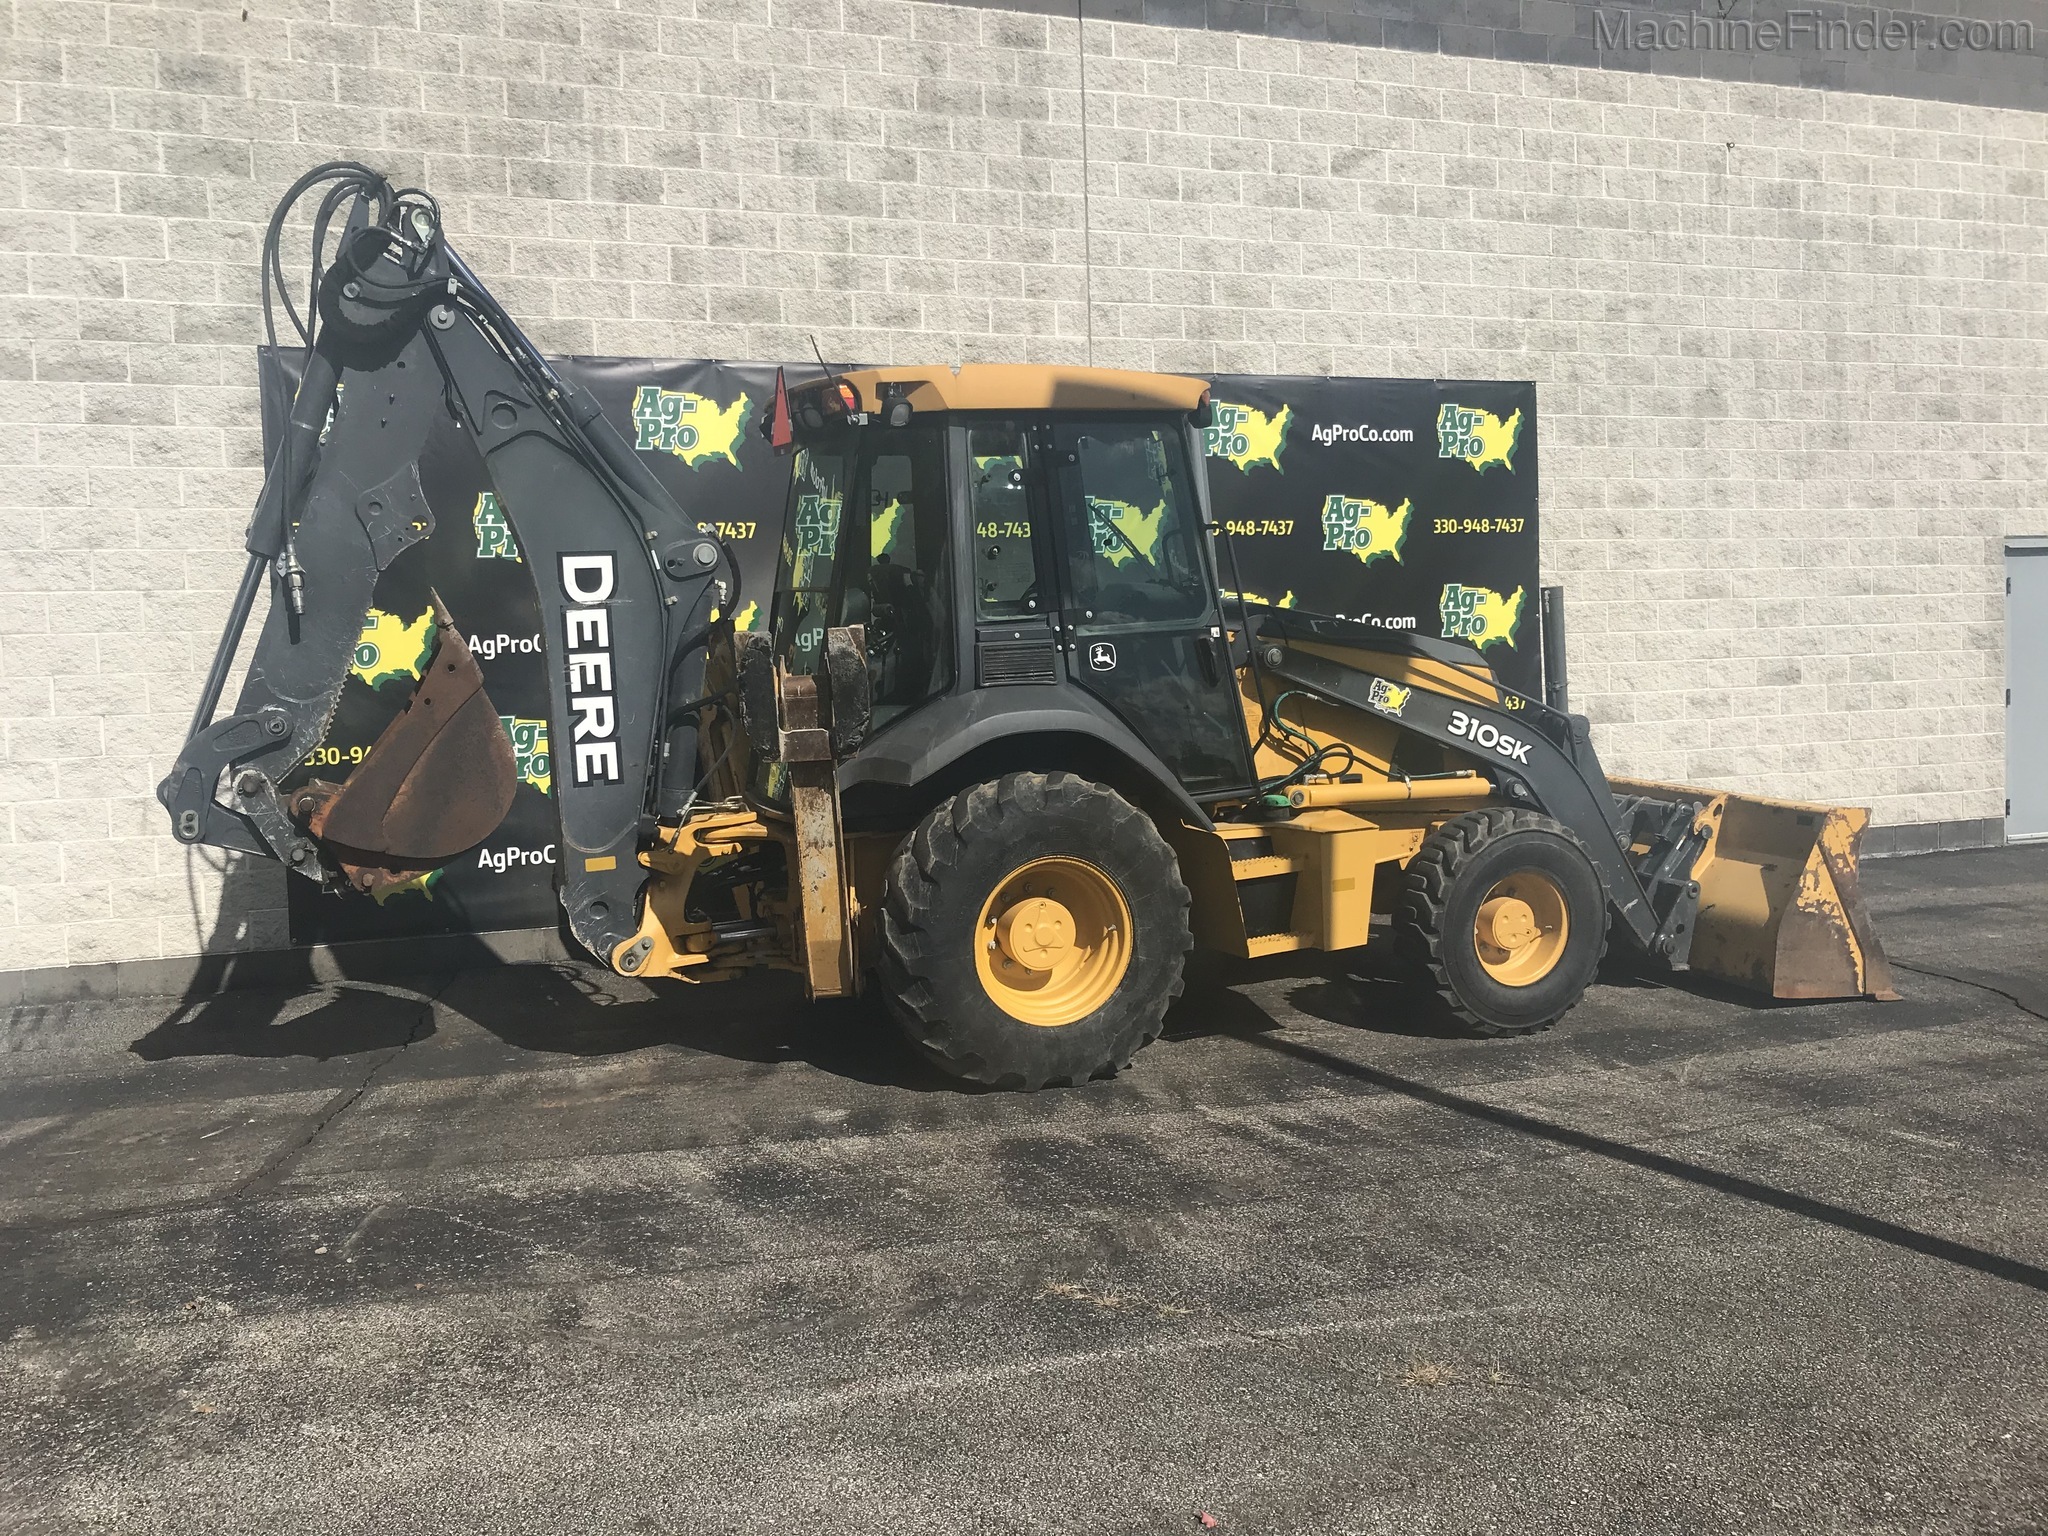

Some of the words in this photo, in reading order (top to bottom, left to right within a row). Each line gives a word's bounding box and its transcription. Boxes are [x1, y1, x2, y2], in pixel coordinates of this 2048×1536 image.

[634, 386, 697, 425] Ag-
[1438, 403, 1484, 437] Ag-
[635, 418, 699, 451] Pro
[1203, 429, 1250, 457] Pro
[1311, 424, 1414, 446] AgProCo.com
[1438, 430, 1486, 458] Pro
[1324, 495, 1373, 528] Ag-
[1433, 519, 1525, 534] 330-948-7437
[1323, 522, 1373, 551] Pro
[1440, 583, 1488, 616] Ag-
[1441, 609, 1488, 638] Pro
[562, 555, 620, 783] DEERE
[1370, 690, 1390, 704] Pro
[1447, 710, 1533, 765] 310SK
[477, 844, 557, 874] AgProC
